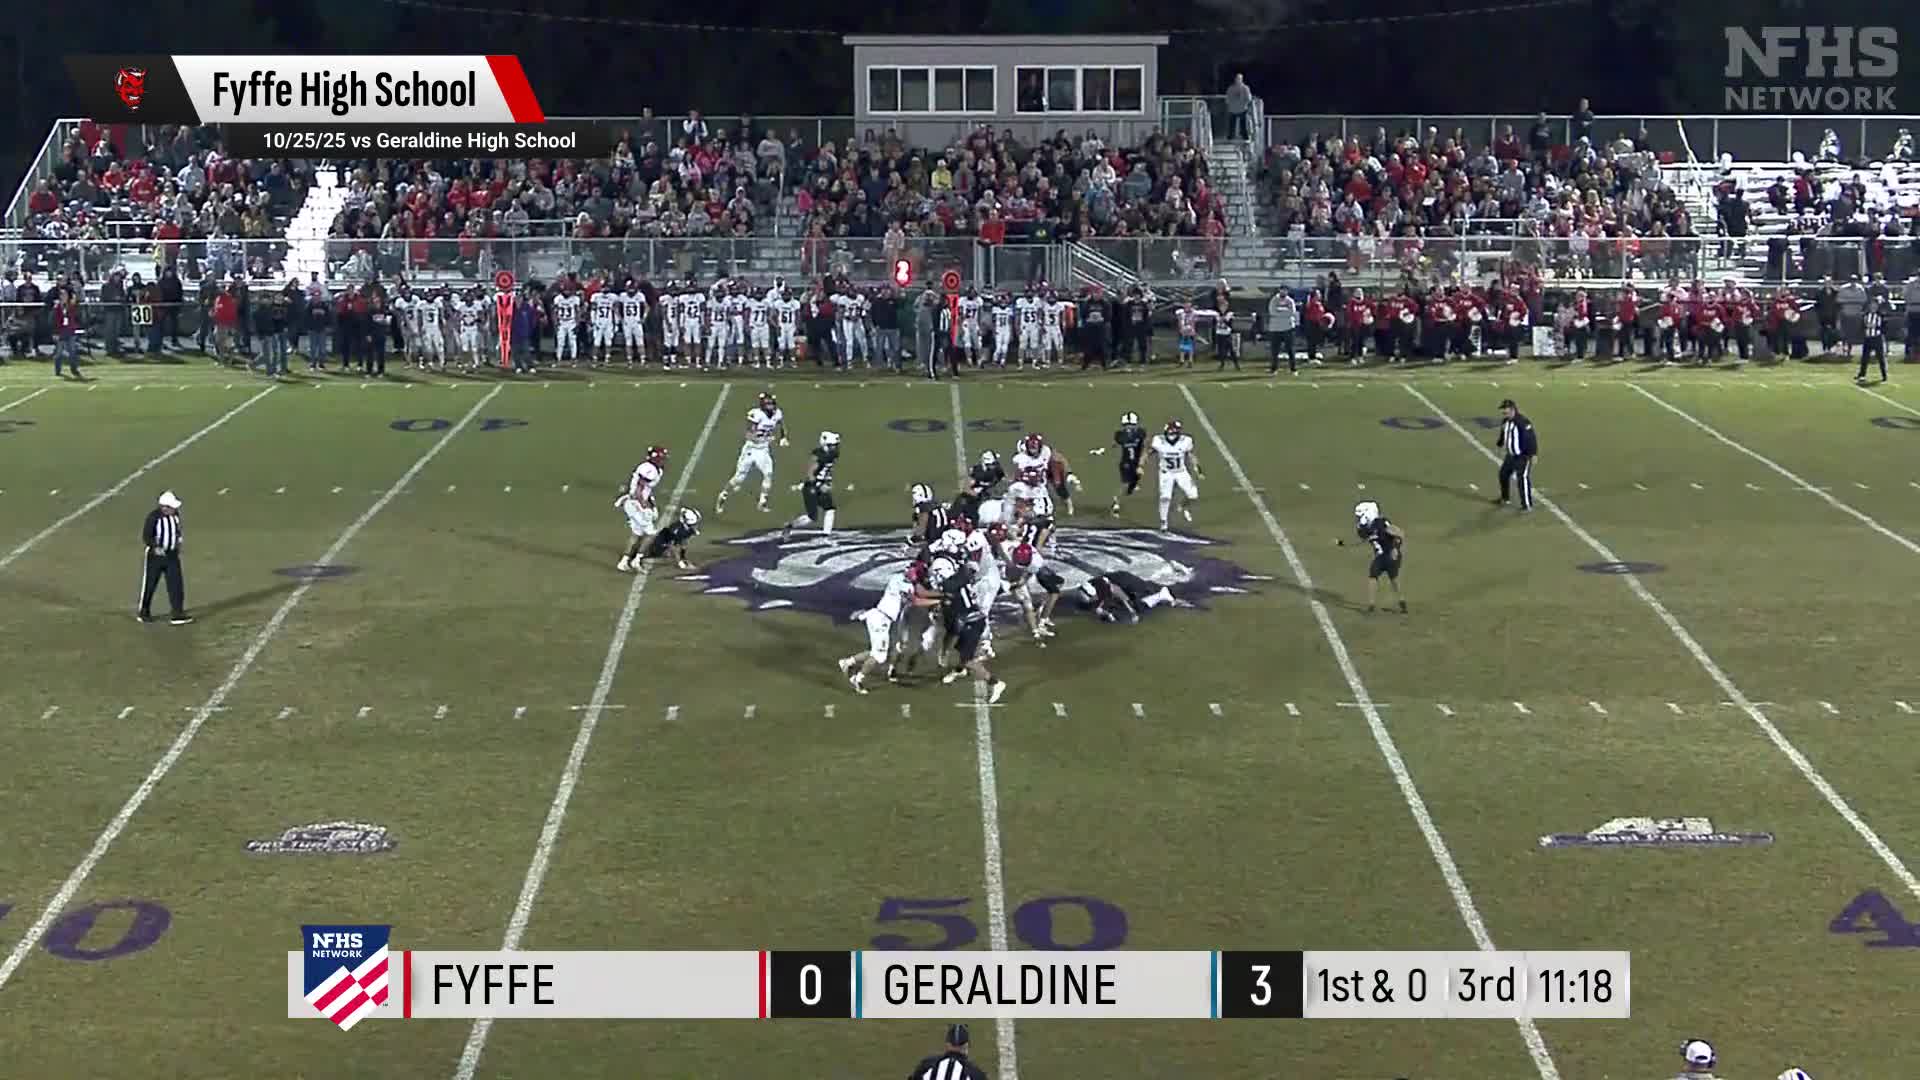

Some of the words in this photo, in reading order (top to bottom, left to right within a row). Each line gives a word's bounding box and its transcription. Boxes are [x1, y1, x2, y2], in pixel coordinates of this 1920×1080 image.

[132, 306, 151, 323] 30
[1165, 458, 1181, 470] 51
[870, 896, 1128, 951] 50
